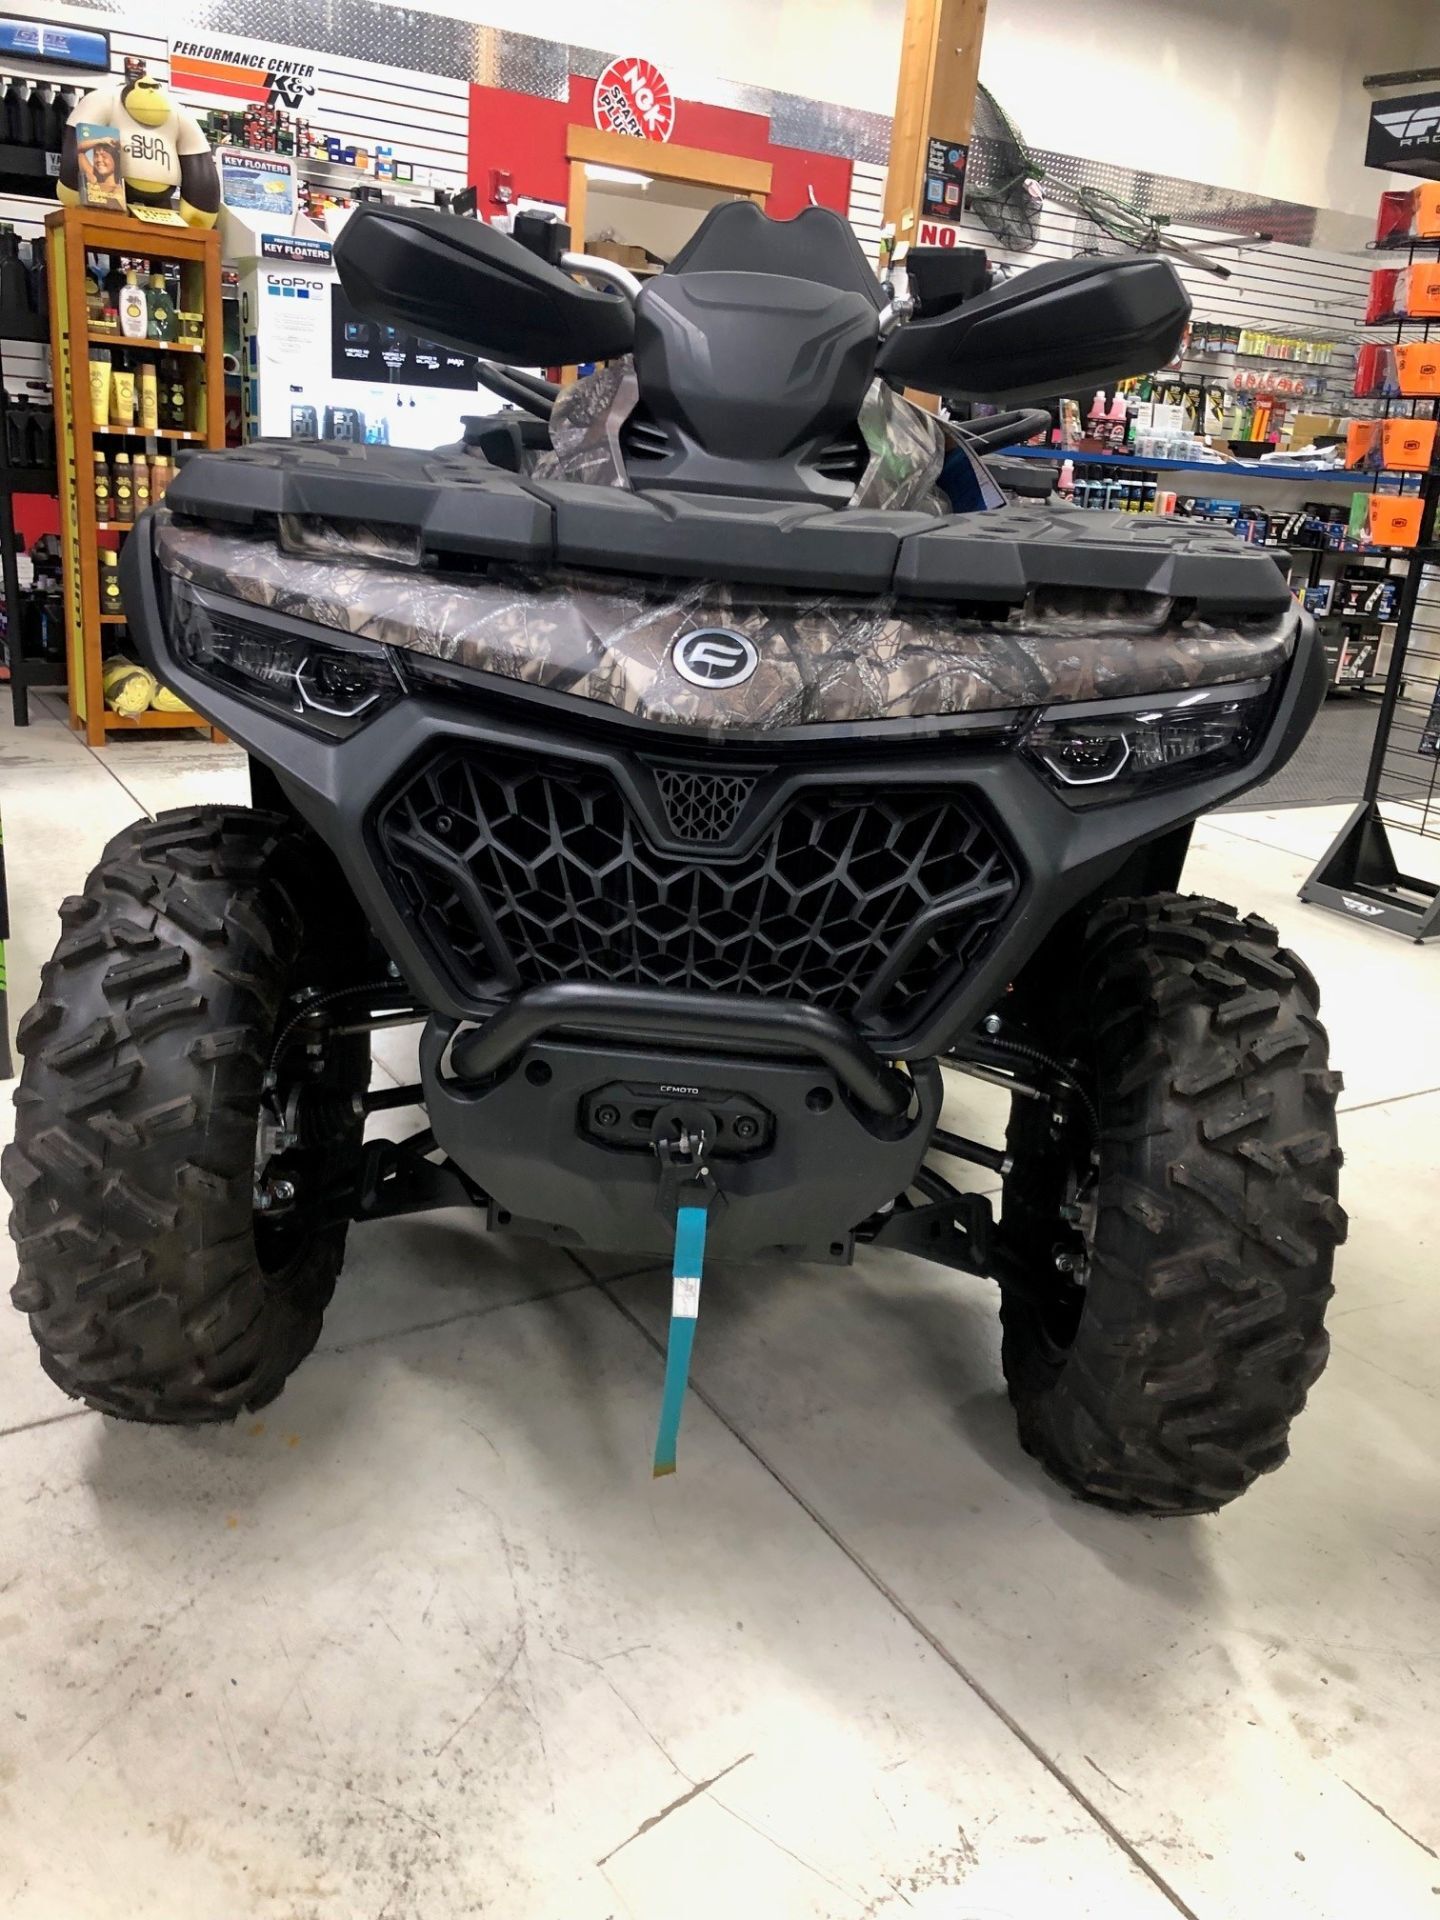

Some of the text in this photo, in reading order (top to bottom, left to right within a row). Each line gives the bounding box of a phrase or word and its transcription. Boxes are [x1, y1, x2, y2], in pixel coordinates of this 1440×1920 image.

[173, 41, 314, 77] PERFORMANCE CENTER
[263, 72, 315, 109] K&N
[622, 65, 666, 132] NGK
[611, 86, 643, 137] SPARK
[225, 155, 289, 174] KEY FLOATERS
[920, 224, 956, 248] NO
[264, 243, 330, 259] KEY FLOATERS
[267, 274, 323, 290] GoPro
[660, 1085, 699, 1095] CFMOTO
